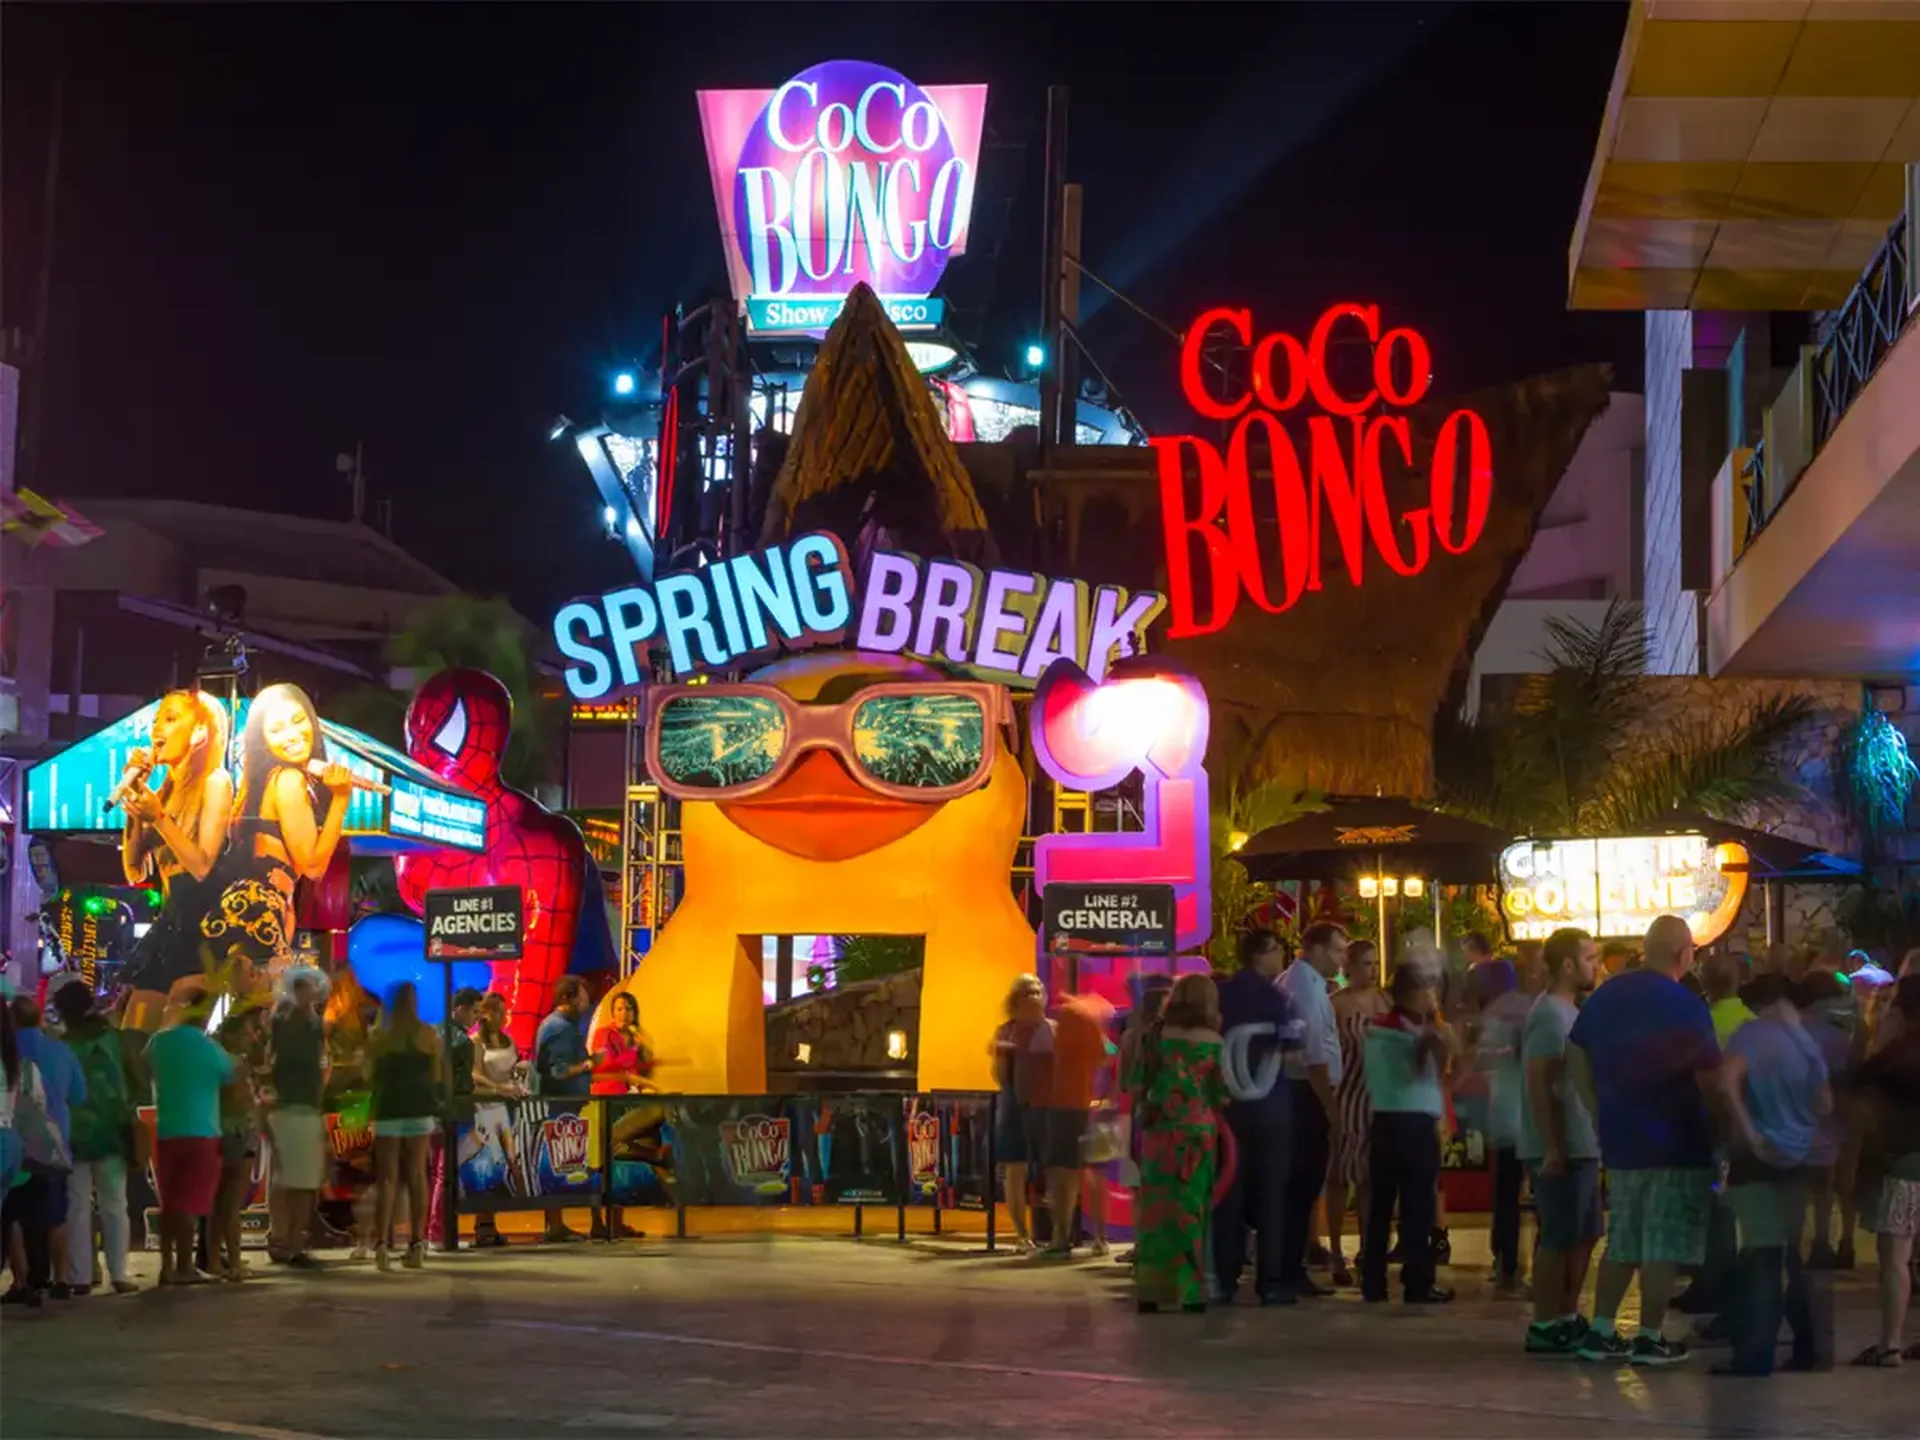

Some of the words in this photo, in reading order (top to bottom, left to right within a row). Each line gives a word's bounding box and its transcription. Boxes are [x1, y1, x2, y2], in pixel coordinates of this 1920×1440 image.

[765, 80, 940, 153] CoCo
[738, 149, 974, 296] BONGO
[765, 302, 829, 325] Show
[1181, 303, 1431, 420] CoCo
[1147, 409, 1493, 639] BONGO
[553, 534, 852, 699] SPRING
[856, 550, 1157, 686] BREAK
[453, 898, 480, 912] LINE
[480, 897, 493, 911] #1
[1084, 895, 1118, 908] LINE
[1120, 895, 1138, 908] #2
[431, 912, 516, 935] AGENCIES
[1058, 909, 1163, 929] GENERAL
[736, 1120, 780, 1141] CoCo
[732, 1138, 788, 1177] BONGO
